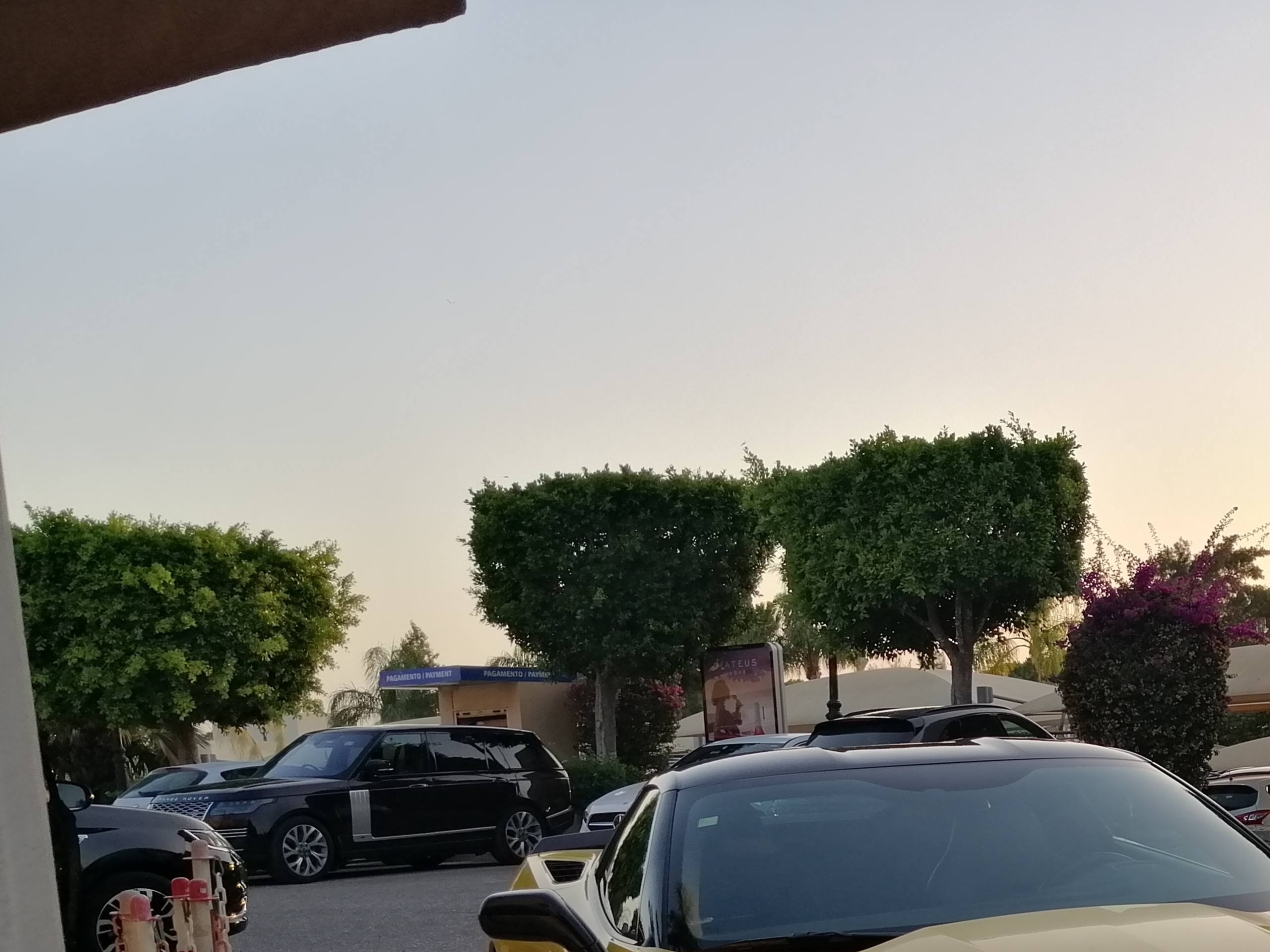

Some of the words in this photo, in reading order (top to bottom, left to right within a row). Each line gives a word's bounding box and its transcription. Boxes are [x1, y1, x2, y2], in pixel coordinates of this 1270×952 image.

[386, 672, 422, 683] PAGAMENTO
[425, 670, 452, 679] PAYMENT
[483, 670, 523, 678] PAGAMENTO
